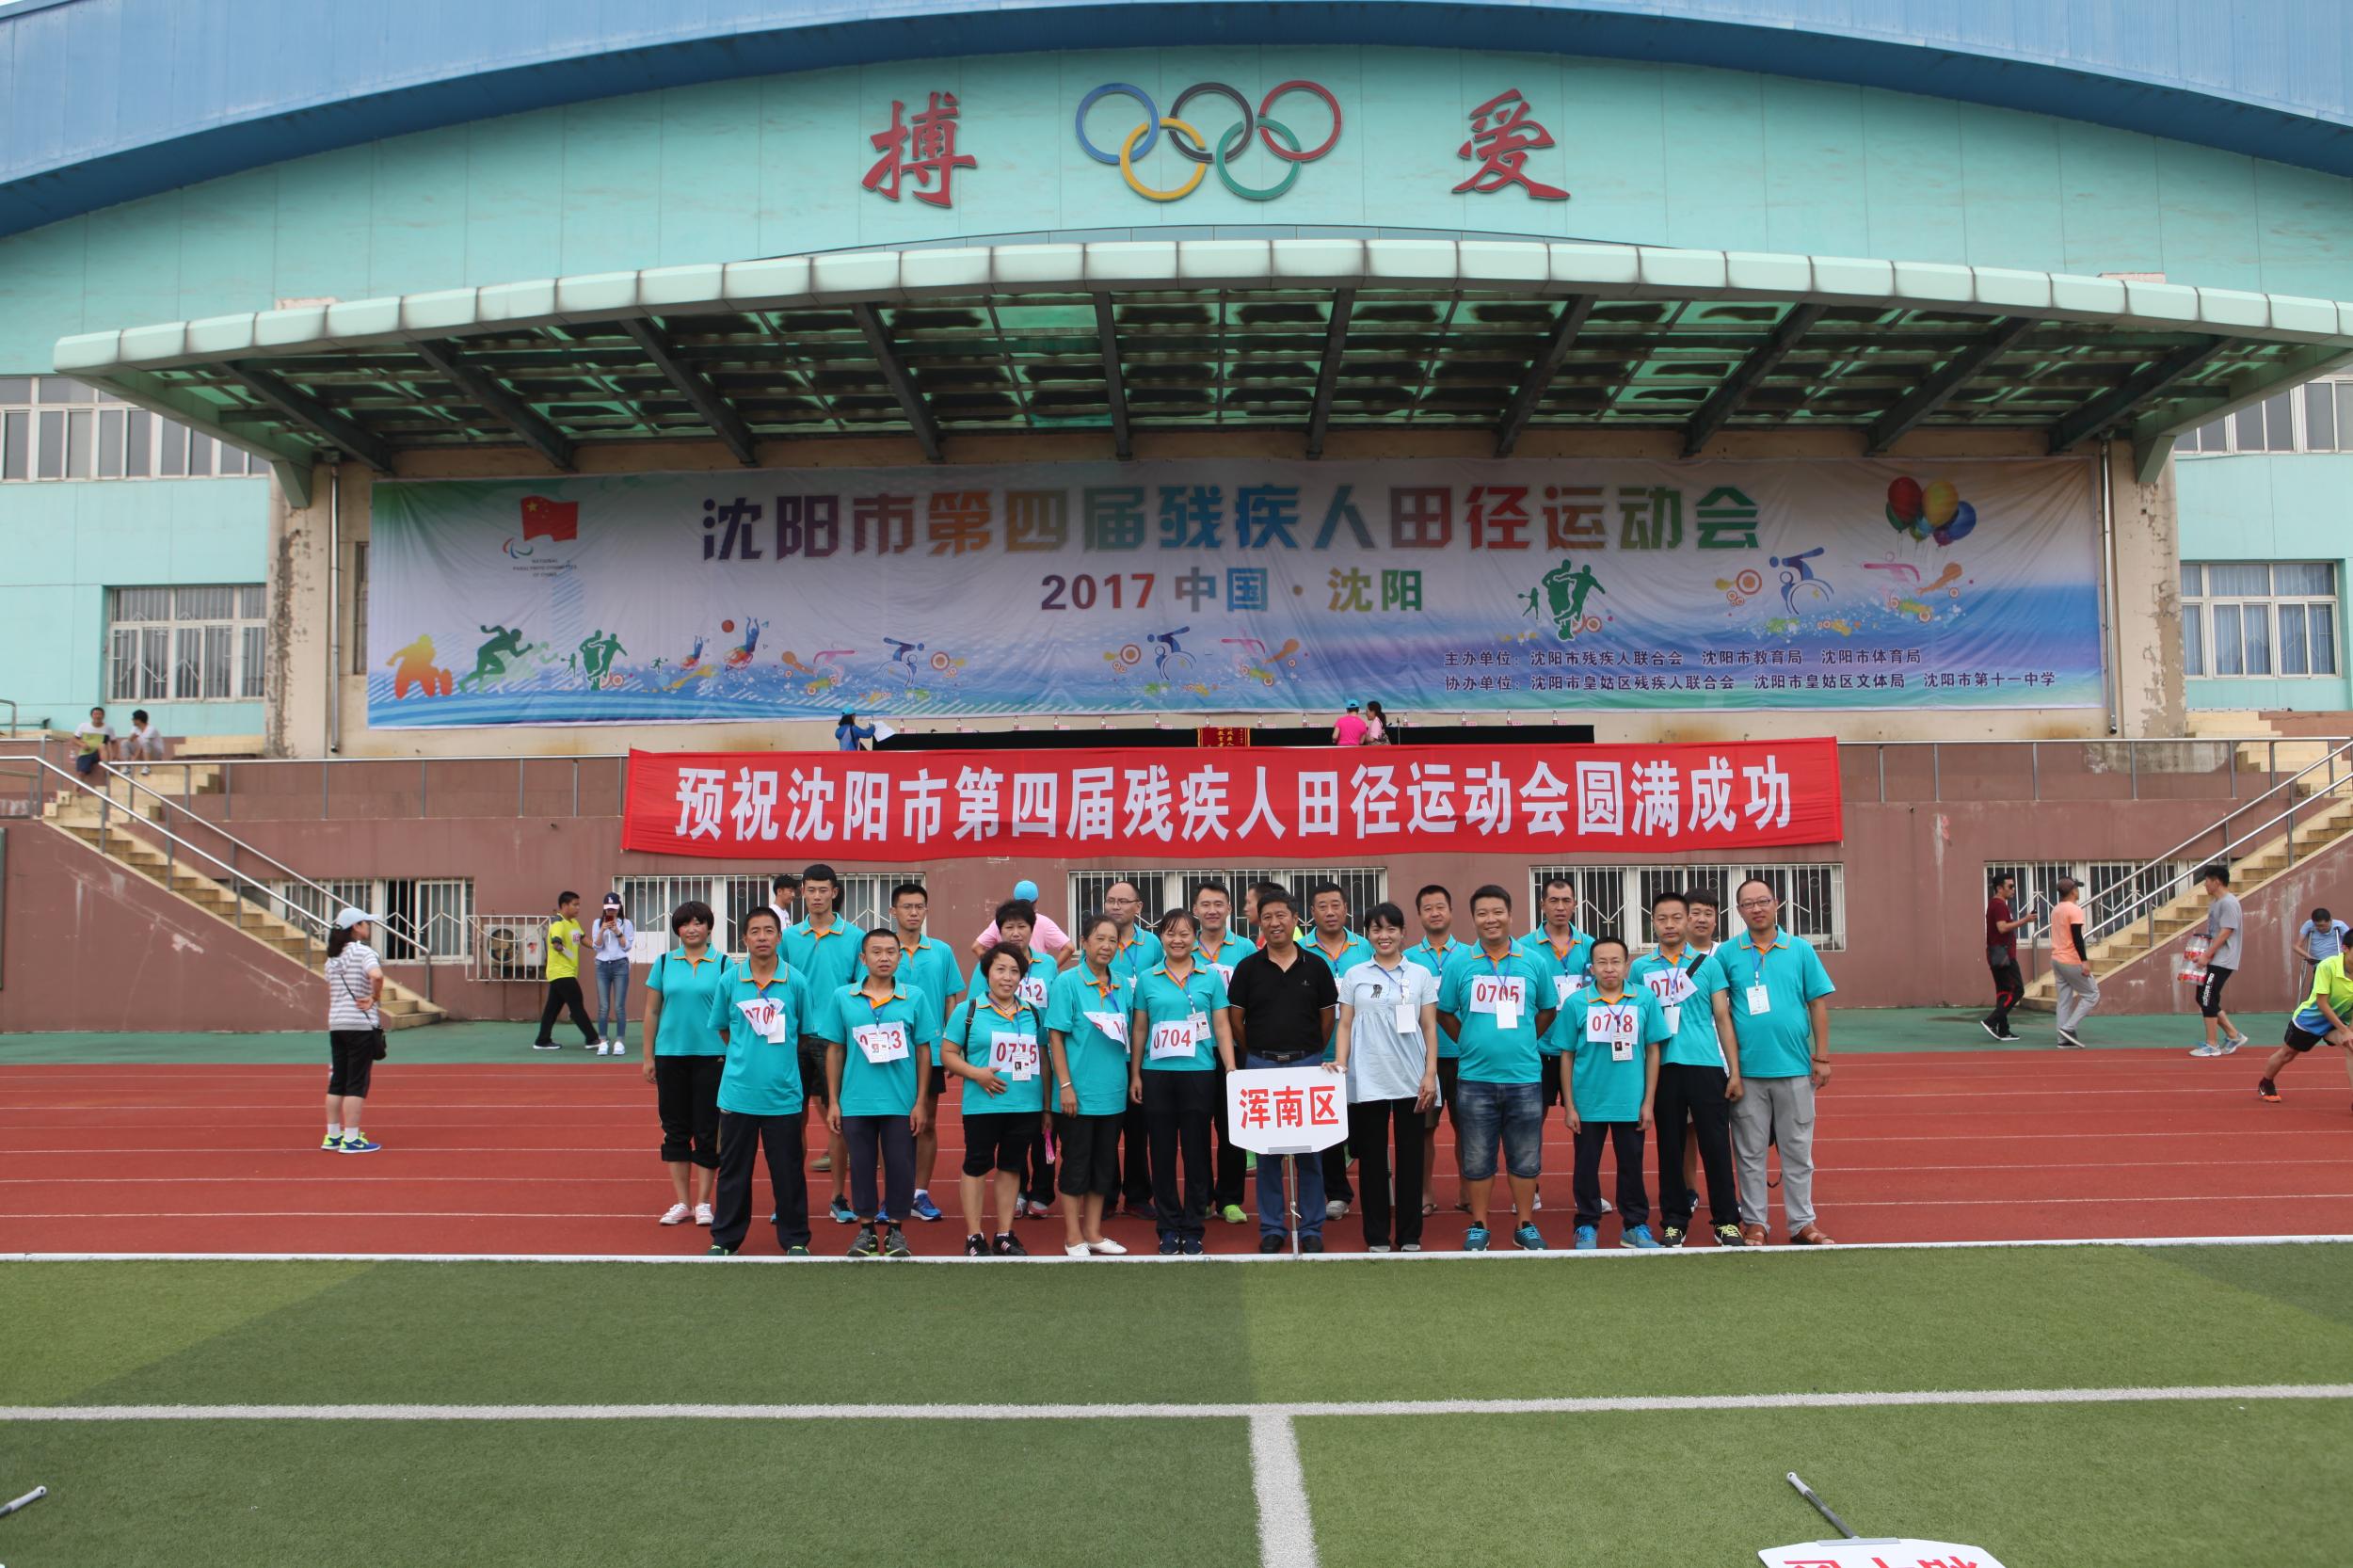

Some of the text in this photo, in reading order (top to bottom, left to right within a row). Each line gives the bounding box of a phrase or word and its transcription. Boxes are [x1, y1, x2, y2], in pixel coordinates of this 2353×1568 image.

[1450, 88, 1570, 200] 爱
[702, 484, 1760, 561] 沈阳市第四届残疾人田径运动会
[1041, 573, 1156, 611] 2017
[1702, 649, 1802, 665] 沈阳市教育局
[1821, 648, 1921, 664] 沈阳市体育局
[1753, 673, 1905, 690] 沈阳市皇姑区文体局
[1923, 671, 2056, 688] 沈阳市第十一中学
[674, 754, 1792, 844] 预祝沈阳市第四届残疾人田径运动会圆满成功
[1153, 1029, 1192, 1049] 0704
[1592, 1014, 1634, 1033] 0718
[1239, 1085, 1339, 1129] 浑南区
